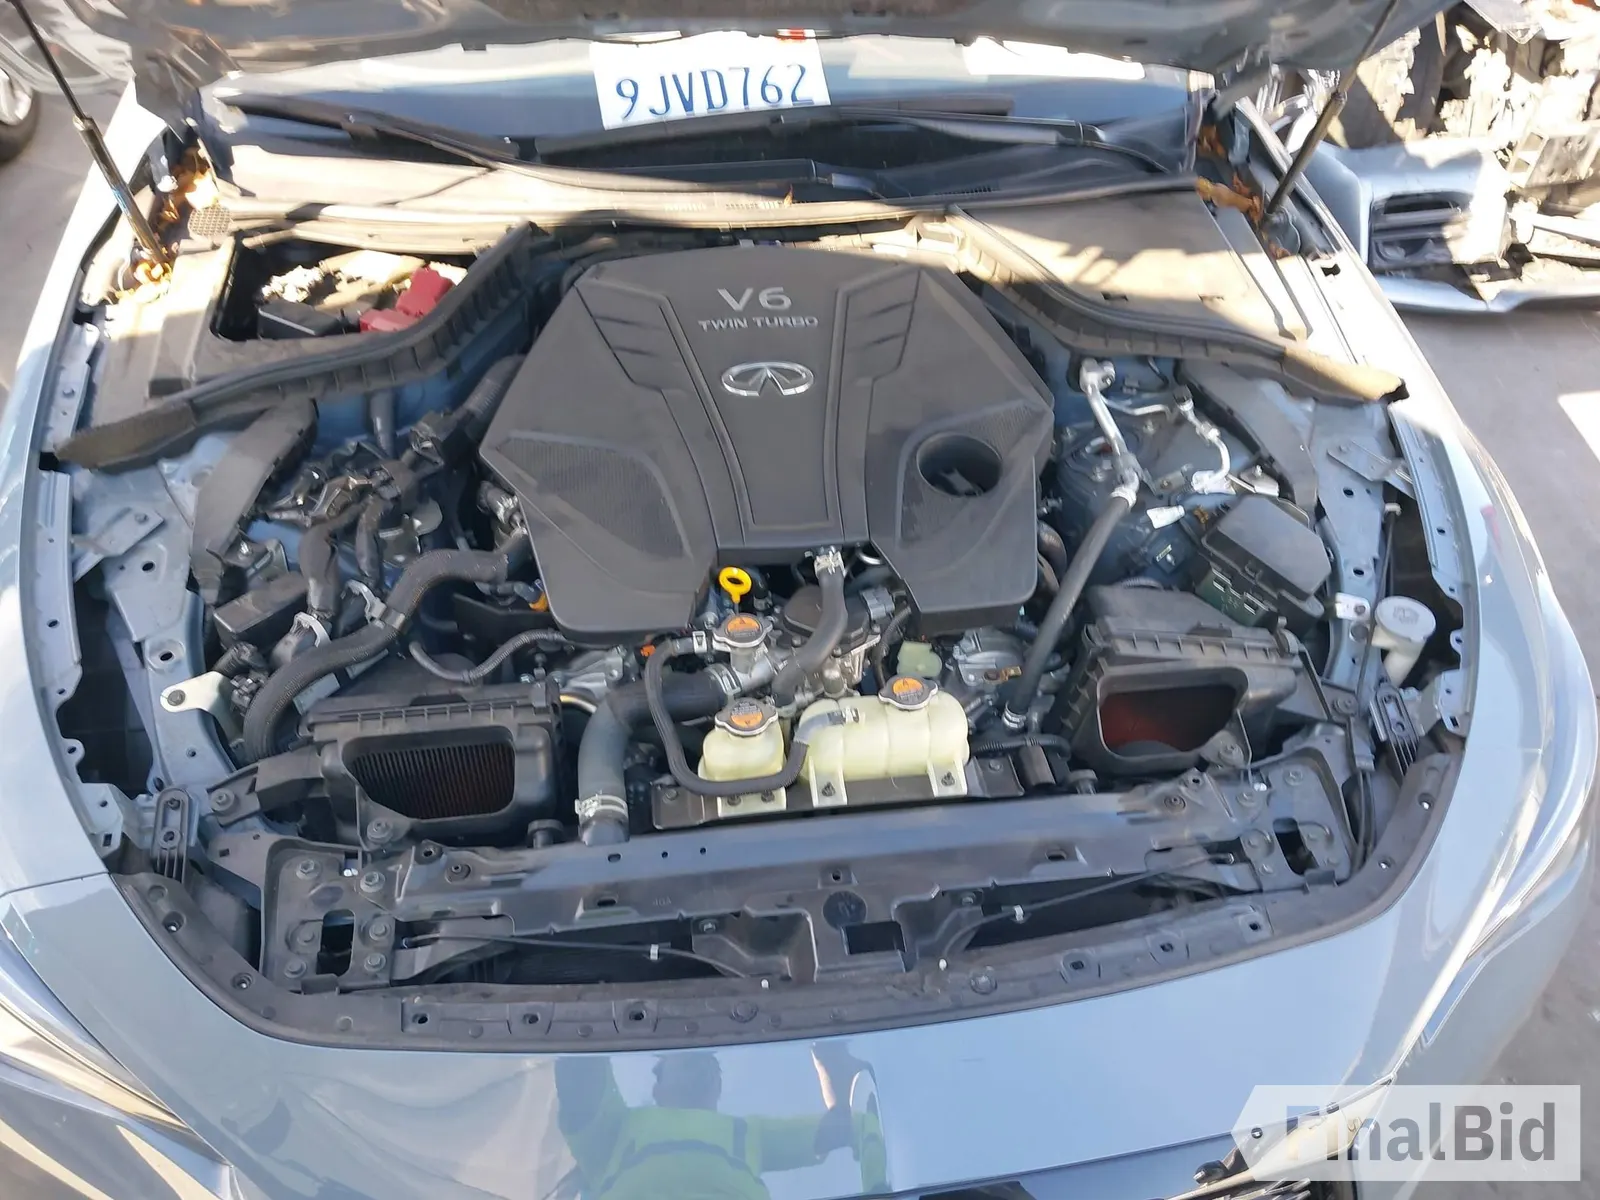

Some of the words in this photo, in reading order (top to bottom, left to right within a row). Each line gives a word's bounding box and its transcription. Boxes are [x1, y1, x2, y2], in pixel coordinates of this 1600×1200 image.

[616, 64, 814, 120] 9JVD762
[717, 286, 792, 312] V6
[698, 317, 749, 332] TWIN
[753, 315, 819, 328] TURBO
